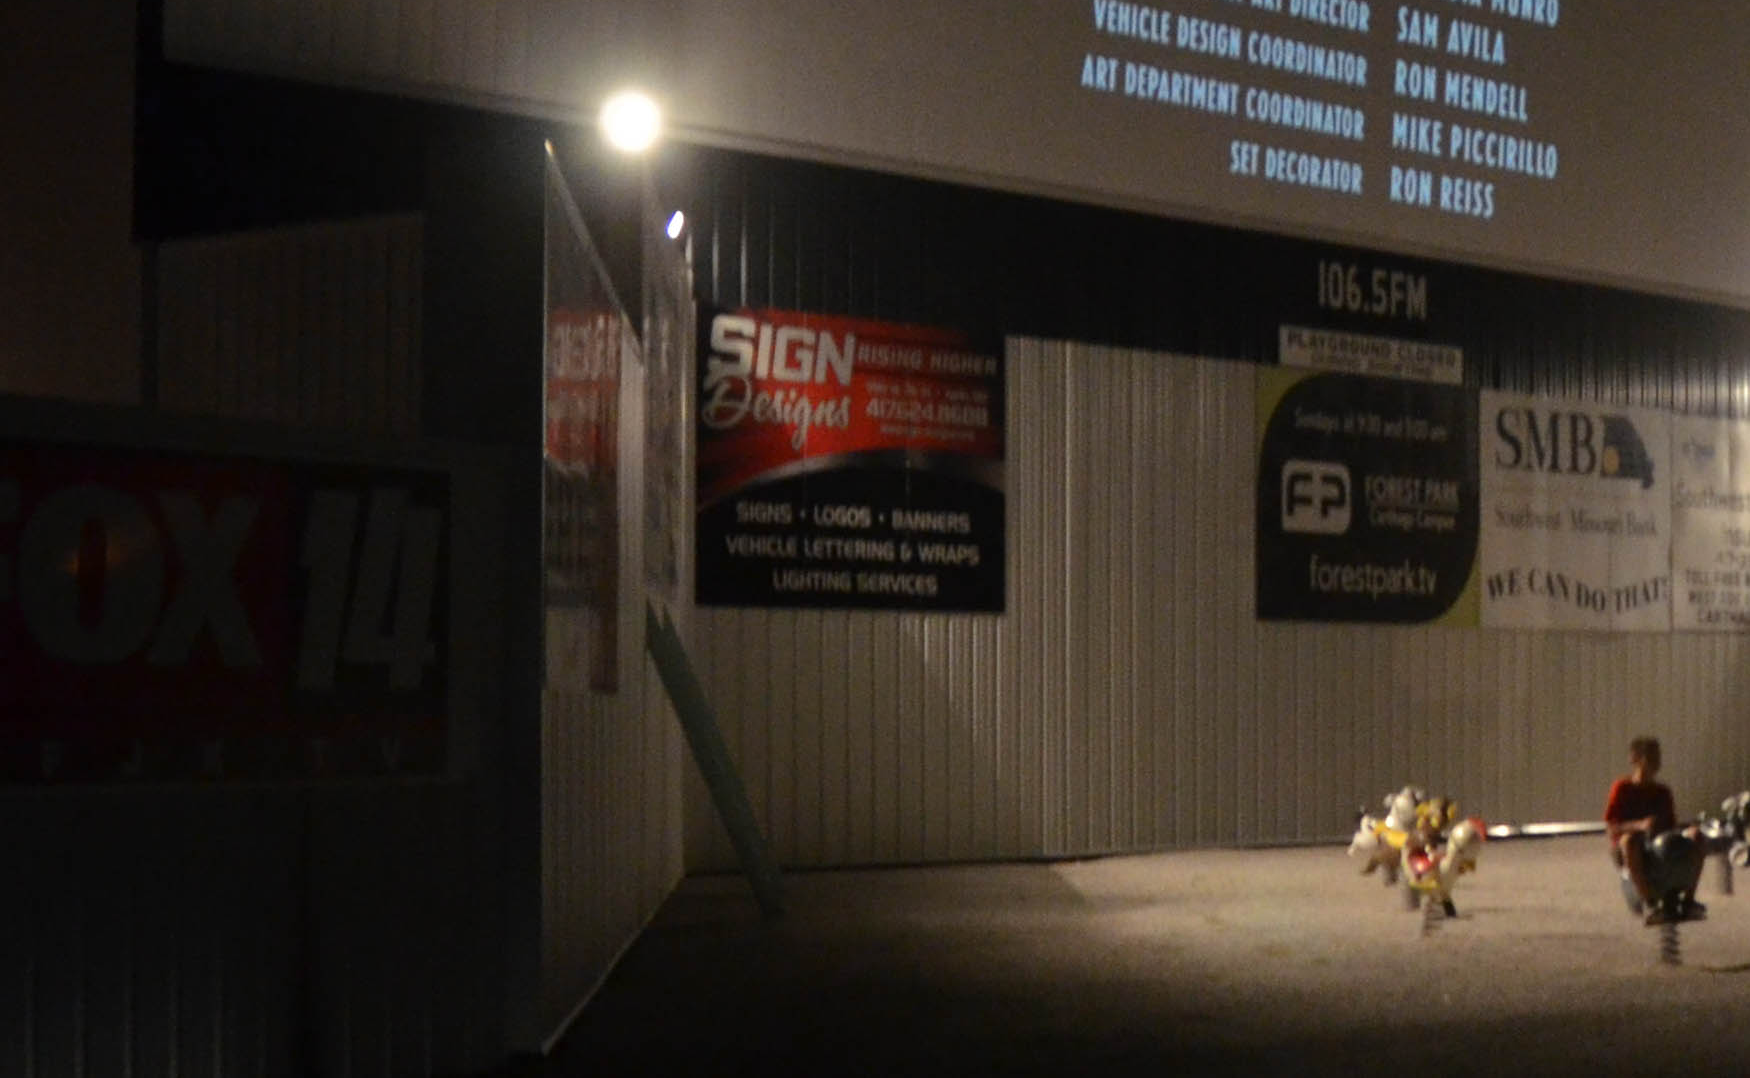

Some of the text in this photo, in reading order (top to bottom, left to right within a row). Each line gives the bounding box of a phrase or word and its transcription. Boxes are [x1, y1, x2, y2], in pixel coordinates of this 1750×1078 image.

[1175, 16, 1241, 56] DESIGN
[1247, 33, 1368, 86] COORDINATOR
[1396, 8, 1505, 64] SAM AVILA
[1080, 57, 1366, 139] ART DEPARTMENT COORDINATOR
[1394, 60, 1528, 122] RON MENDELL
[1229, 141, 1364, 194] SET DECORATOR
[1392, 116, 1559, 179] MIKE PICCIRILLO
[1388, 167, 1496, 220] RON REISS
[1318, 259, 1428, 320] 106.5FM
[707, 314, 855, 387] SIGN
[703, 375, 851, 449] Designs
[1495, 408, 1597, 474] SMB
[737, 502, 970, 534] SIGNS LOGOS BANNERS
[725, 535, 796, 557] VEHICLE
[804, 537, 895, 562] LETTERING
[918, 543, 981, 567] WRAPS
[0, 477, 441, 691] OX 14
[773, 570, 938, 595] LIGHTING SERVICES
[1487, 568, 1522, 602] WE
[1528, 567, 1570, 604] CAN
[1576, 581, 1607, 613] DO
